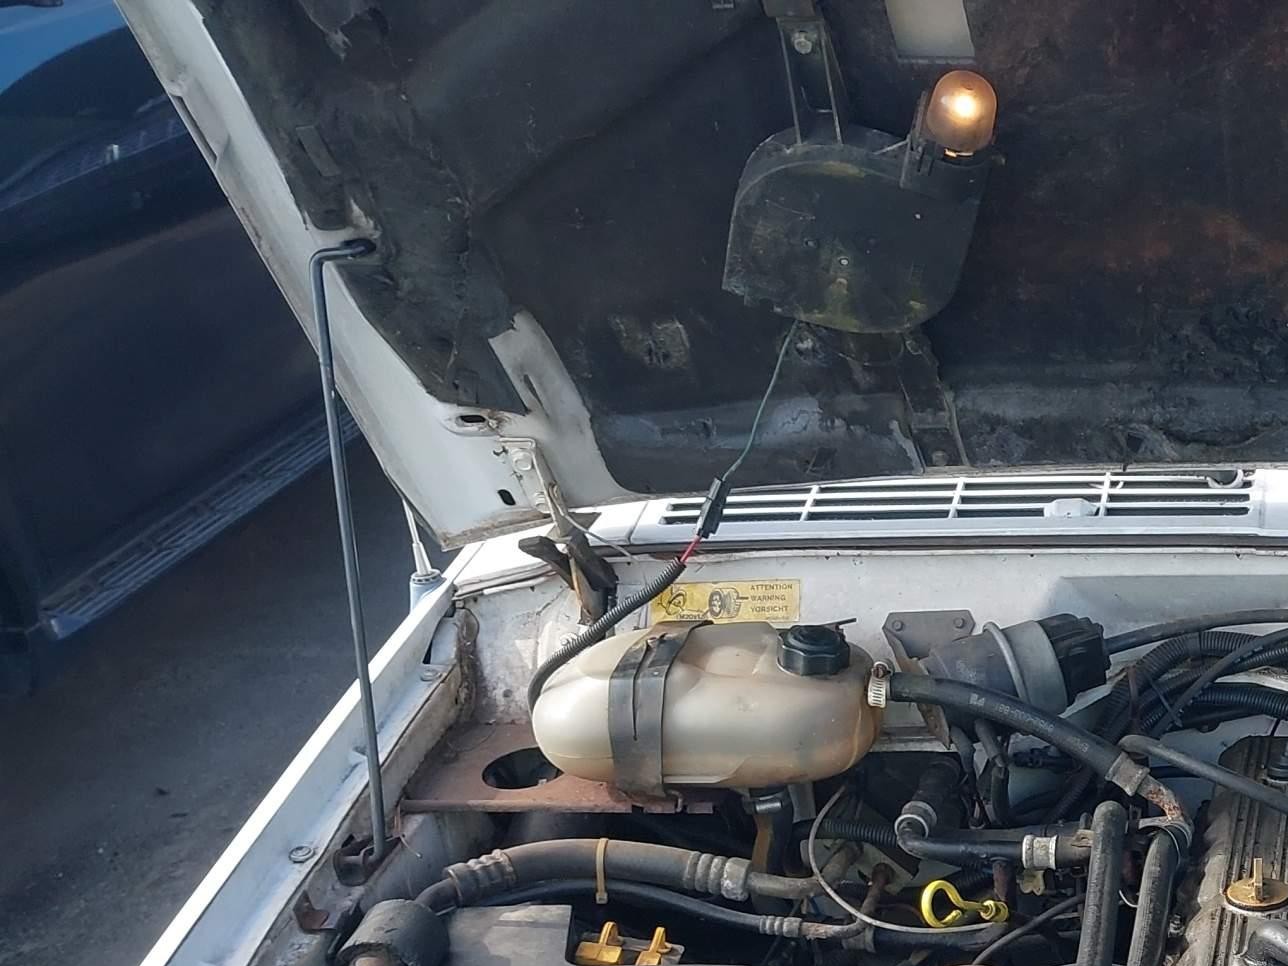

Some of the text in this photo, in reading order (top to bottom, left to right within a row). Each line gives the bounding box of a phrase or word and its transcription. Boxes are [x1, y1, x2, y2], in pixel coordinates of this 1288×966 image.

[750, 583, 793, 591] ATTENTION
[750, 594, 786, 603] WARNING
[750, 605, 789, 614] VORSICHT
